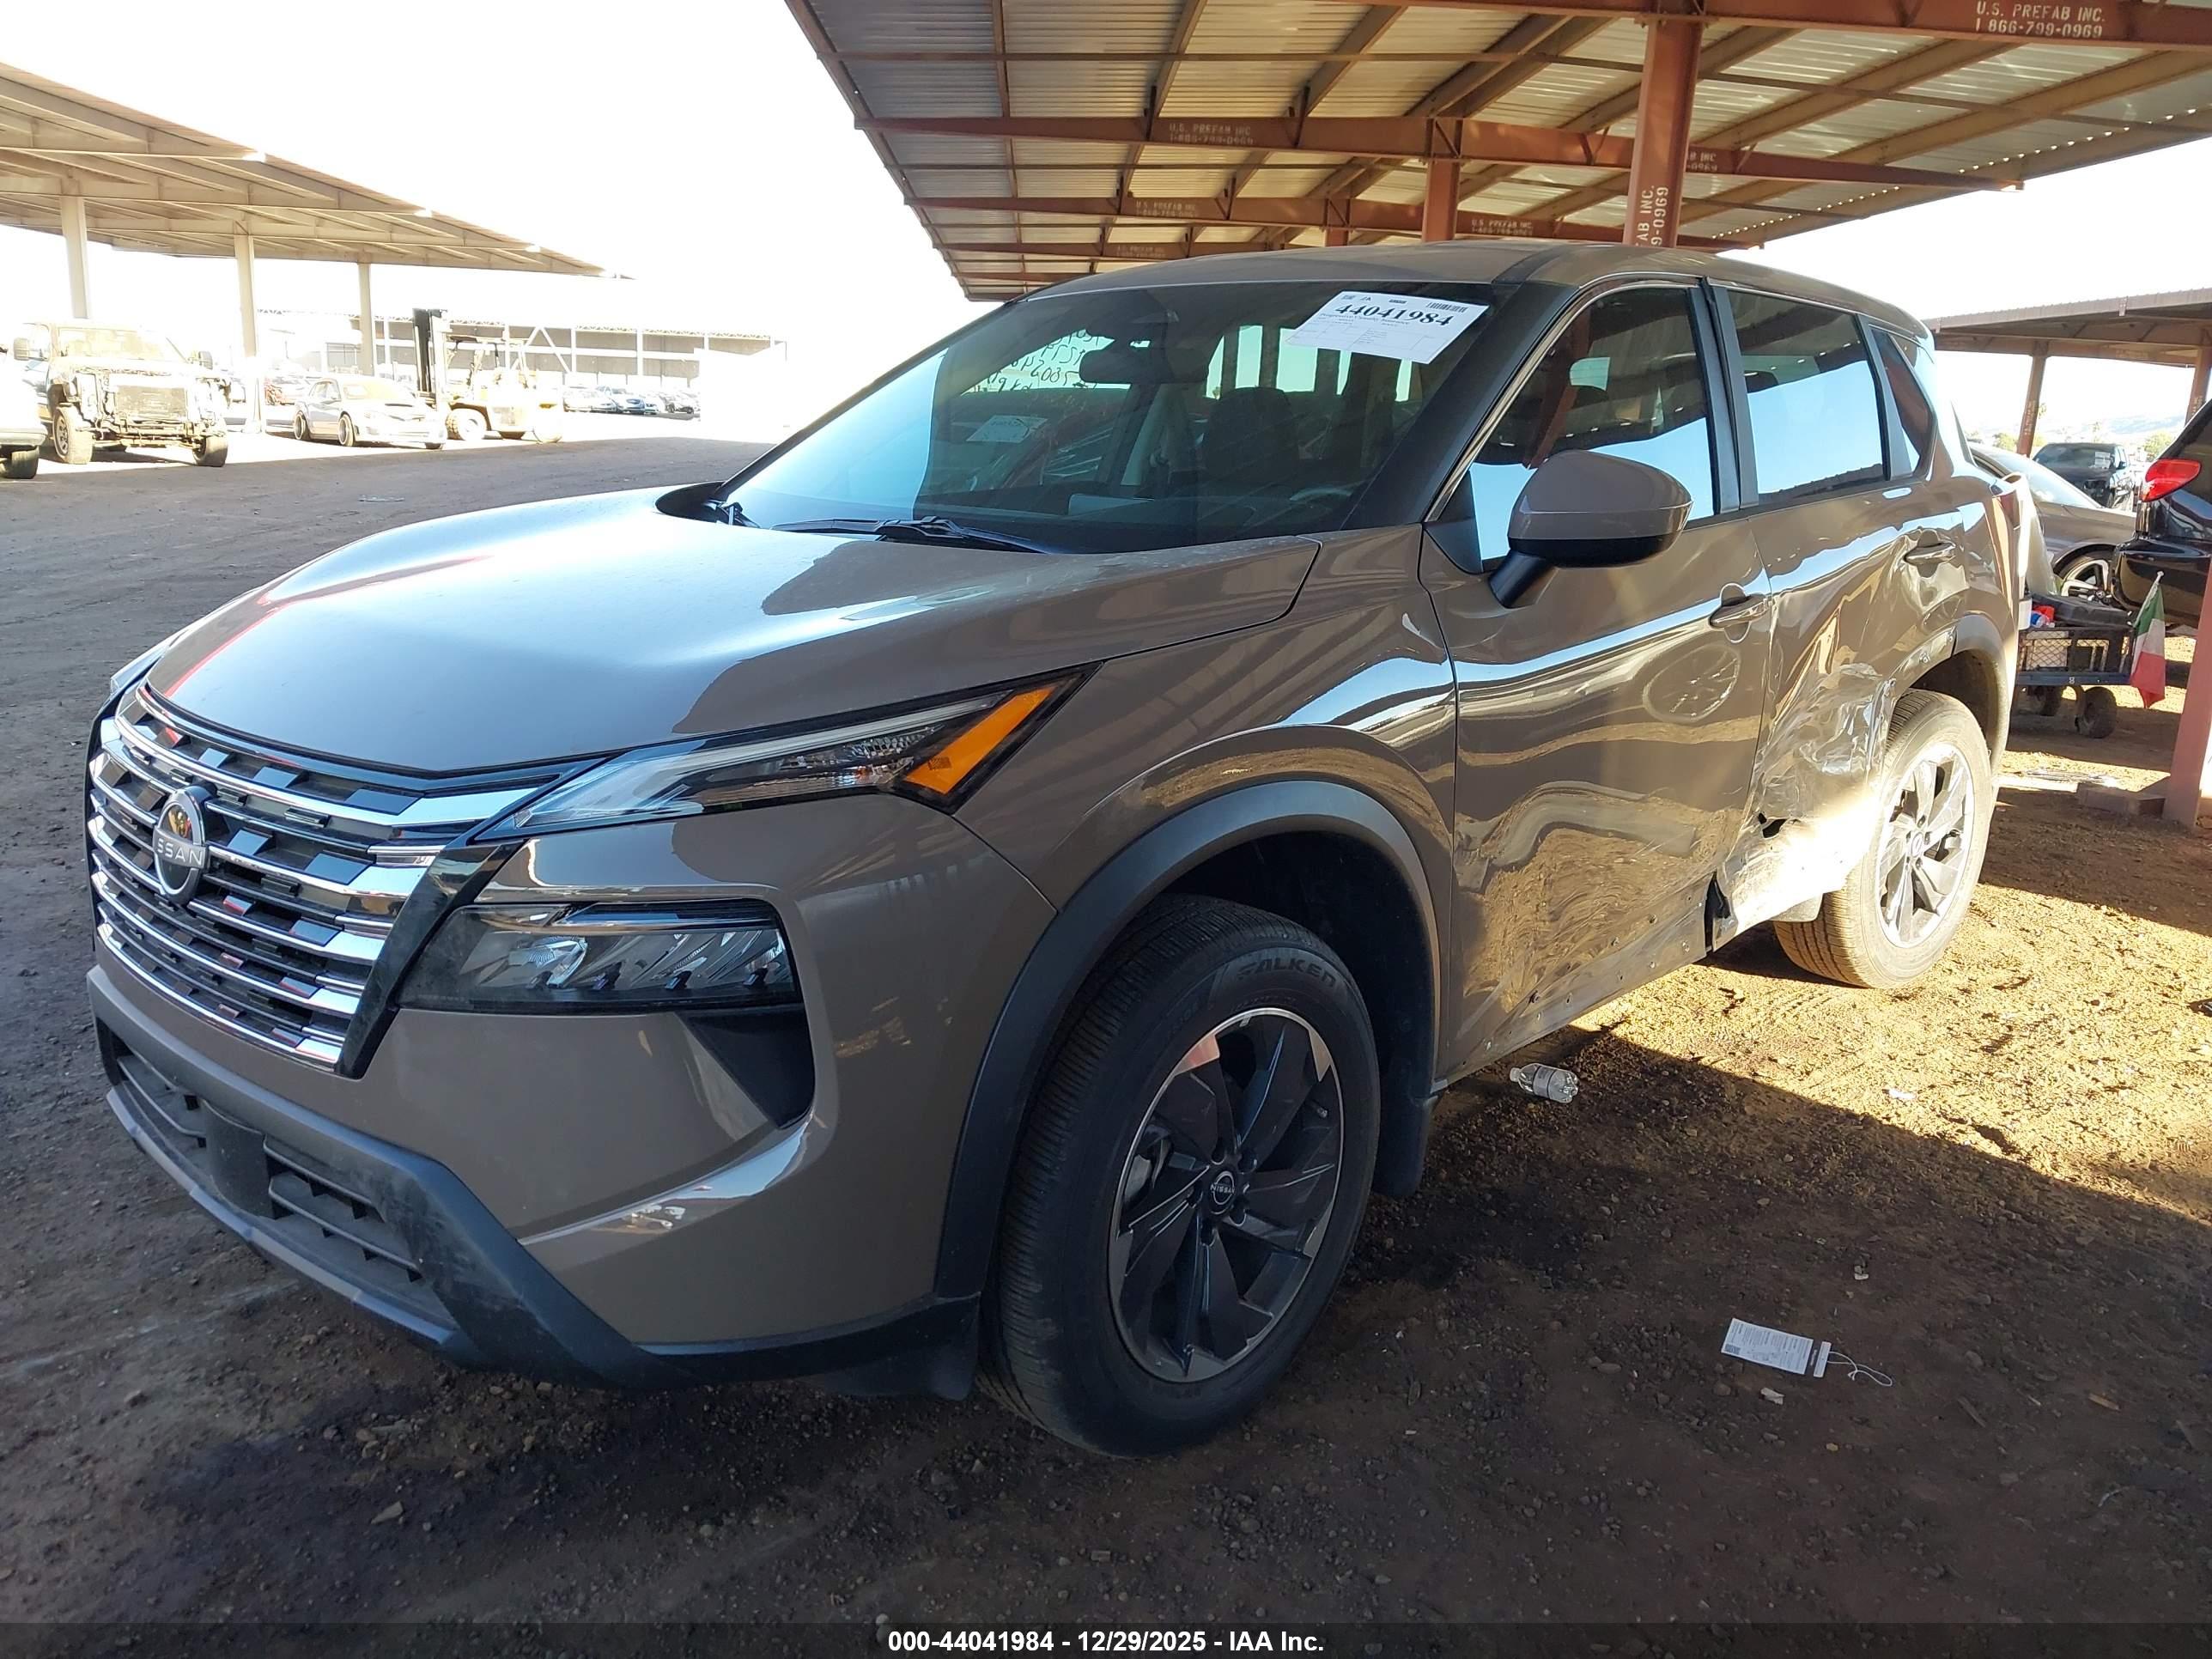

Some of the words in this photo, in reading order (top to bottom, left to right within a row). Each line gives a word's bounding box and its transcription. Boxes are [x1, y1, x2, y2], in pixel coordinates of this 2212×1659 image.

[1976, 1, 2004, 17] U.S.
[2012, 4, 2070, 21] PREFAB
[2077, 7, 2106, 22] INC.
[1639, 185, 1655, 214] INC.
[1335, 304, 1455, 326] 44041984
[157, 836, 204, 866] SSAN
